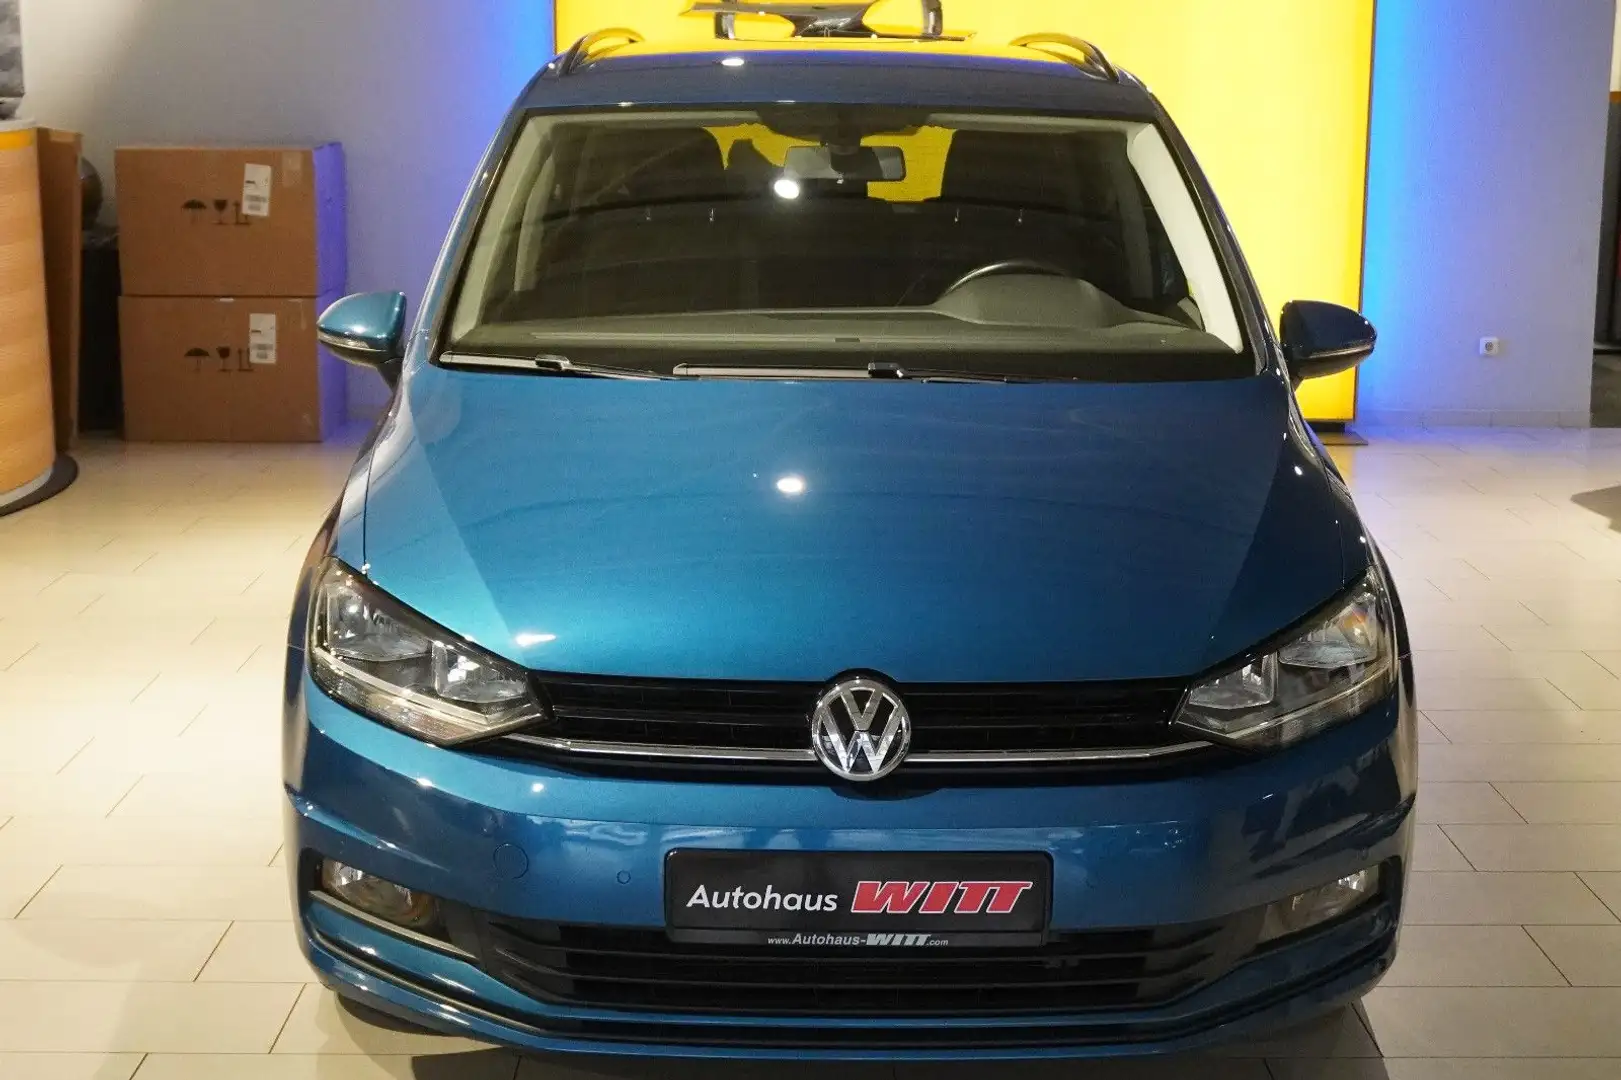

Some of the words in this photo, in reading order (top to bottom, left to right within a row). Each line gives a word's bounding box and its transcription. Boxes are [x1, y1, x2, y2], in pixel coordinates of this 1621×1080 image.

[686, 884, 838, 912] Autohaus
[850, 880, 1033, 914] WITT
[767, 933, 949, 946] www.Autohaus-WITT.com
